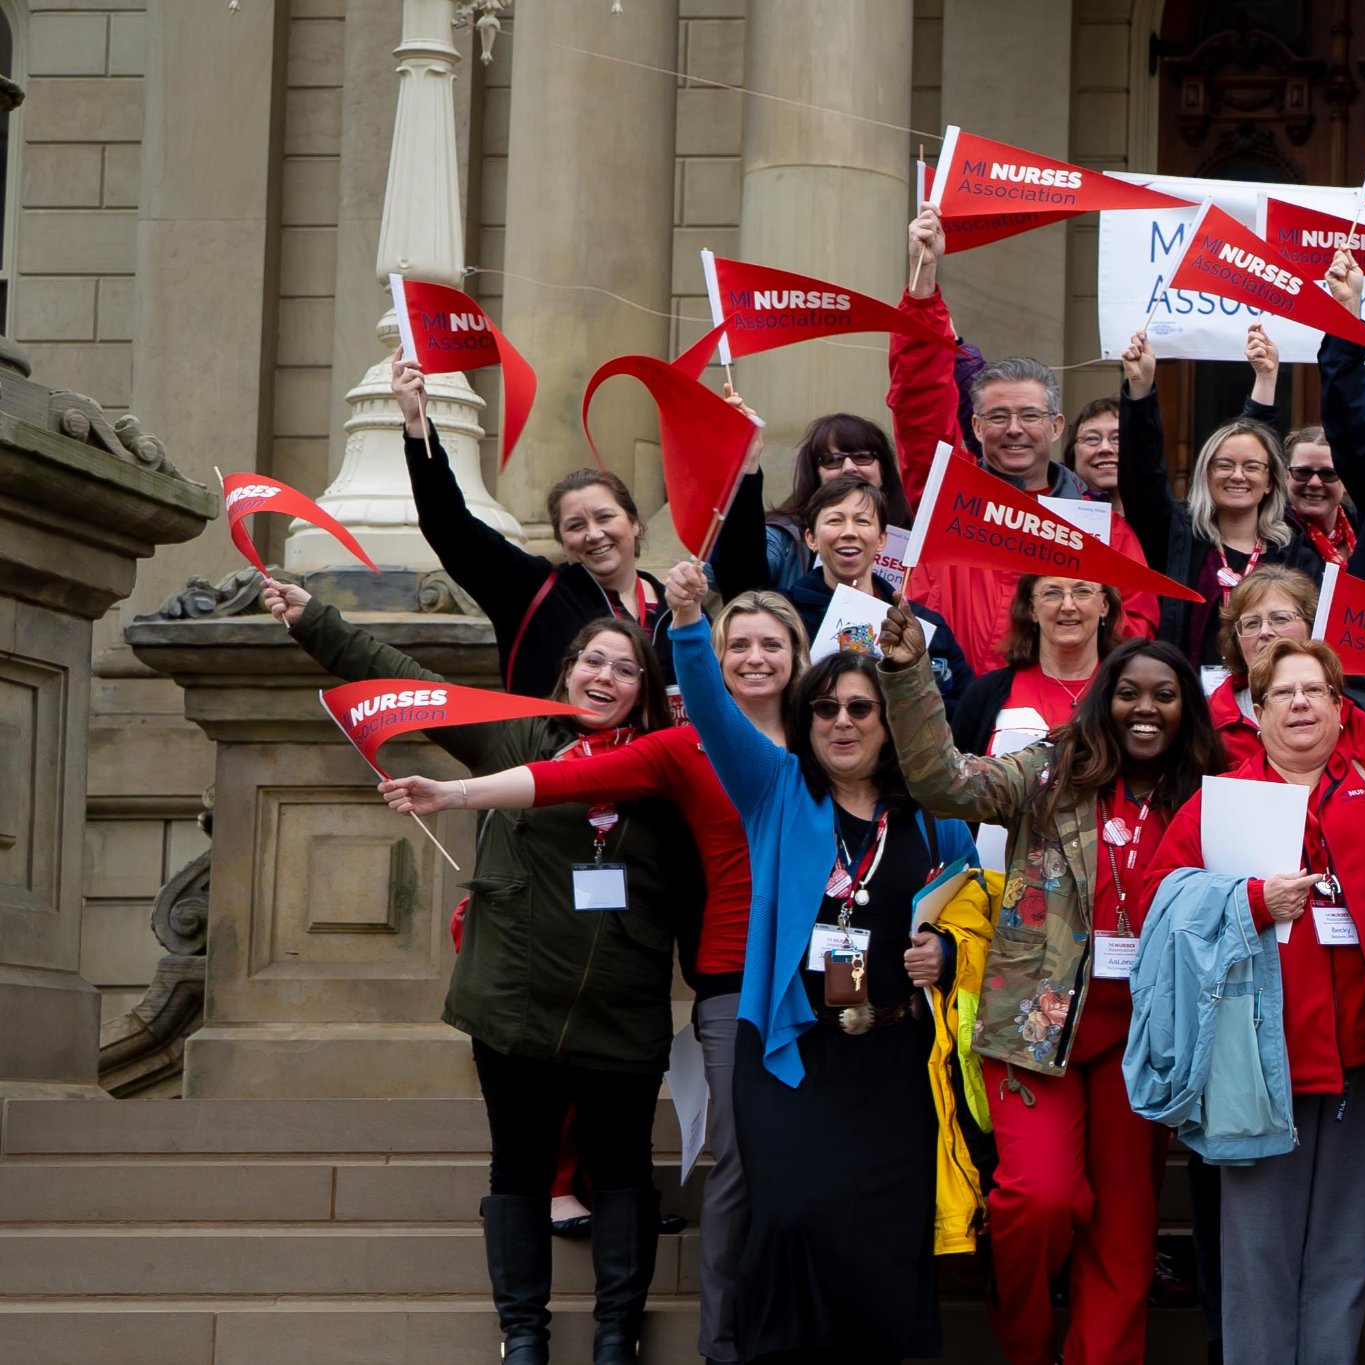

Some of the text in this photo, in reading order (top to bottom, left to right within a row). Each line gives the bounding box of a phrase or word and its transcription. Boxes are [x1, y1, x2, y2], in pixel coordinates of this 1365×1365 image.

[990, 163, 1082, 189] NURSES
[1219, 243, 1304, 295] NURSES
[753, 290, 852, 310] NURSES
[983, 501, 1084, 551] NURSES
[350, 688, 449, 728] NURSES
[1331, 926, 1351, 935] Becky
